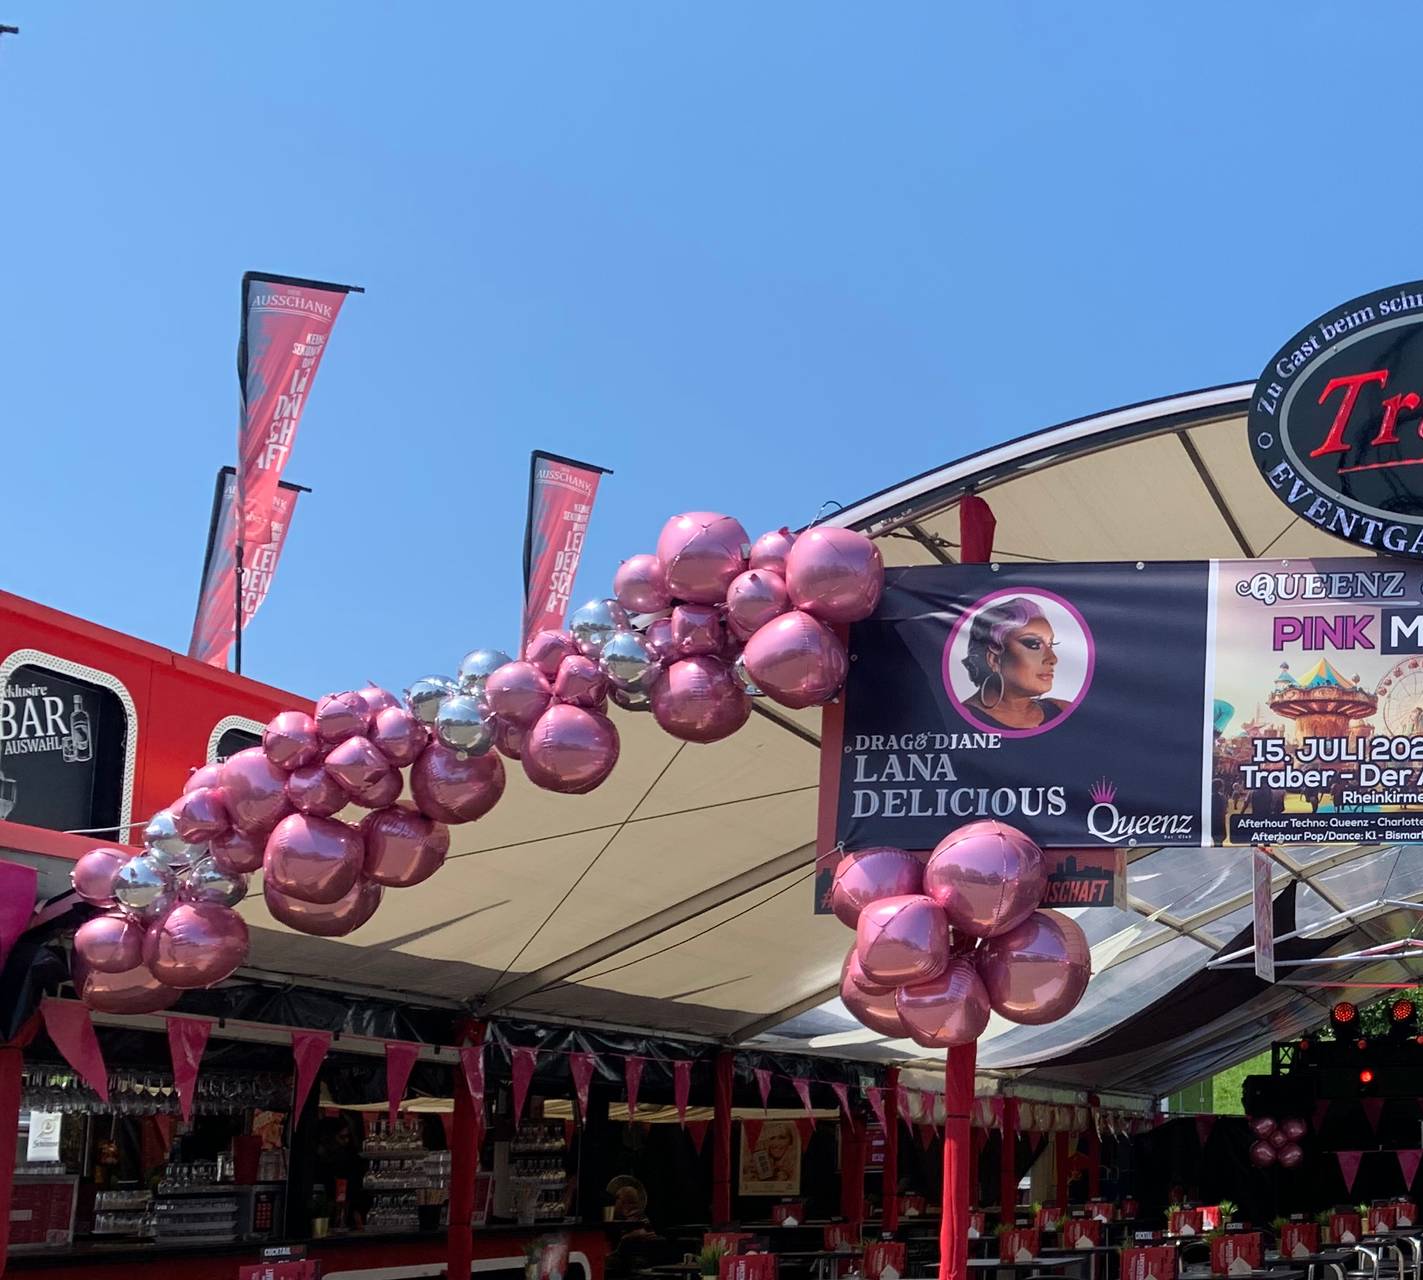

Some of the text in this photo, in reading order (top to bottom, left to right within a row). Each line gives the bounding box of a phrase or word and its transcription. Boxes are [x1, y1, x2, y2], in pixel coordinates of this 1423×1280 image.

[252, 294, 333, 318] AUSSCHANK
[1257, 382, 1284, 416] Zu
[1276, 334, 1321, 379] Gast
[1318, 305, 1376, 342] beim
[1236, 571, 1406, 605] QUEENZ
[1273, 615, 1375, 651] PINK
[0, 696, 69, 740] BAR
[4, 736, 62, 755] AUSWAHL
[1252, 738, 1291, 762] 15.
[1297, 737, 1365, 761] JULI
[853, 753, 958, 782] LANA
[1240, 765, 1335, 788] Traber
[1360, 763, 1412, 787] Der
[851, 785, 1067, 818] DELICIOUS
[1087, 803, 1193, 843] Queenz
[1238, 818, 1288, 829] Afterhour
[1290, 818, 1328, 828] Techno:
[1330, 817, 1369, 829] Queenz
[1251, 831, 1301, 842] Afterhour
[1303, 830, 1364, 843] Pop/Dance:
